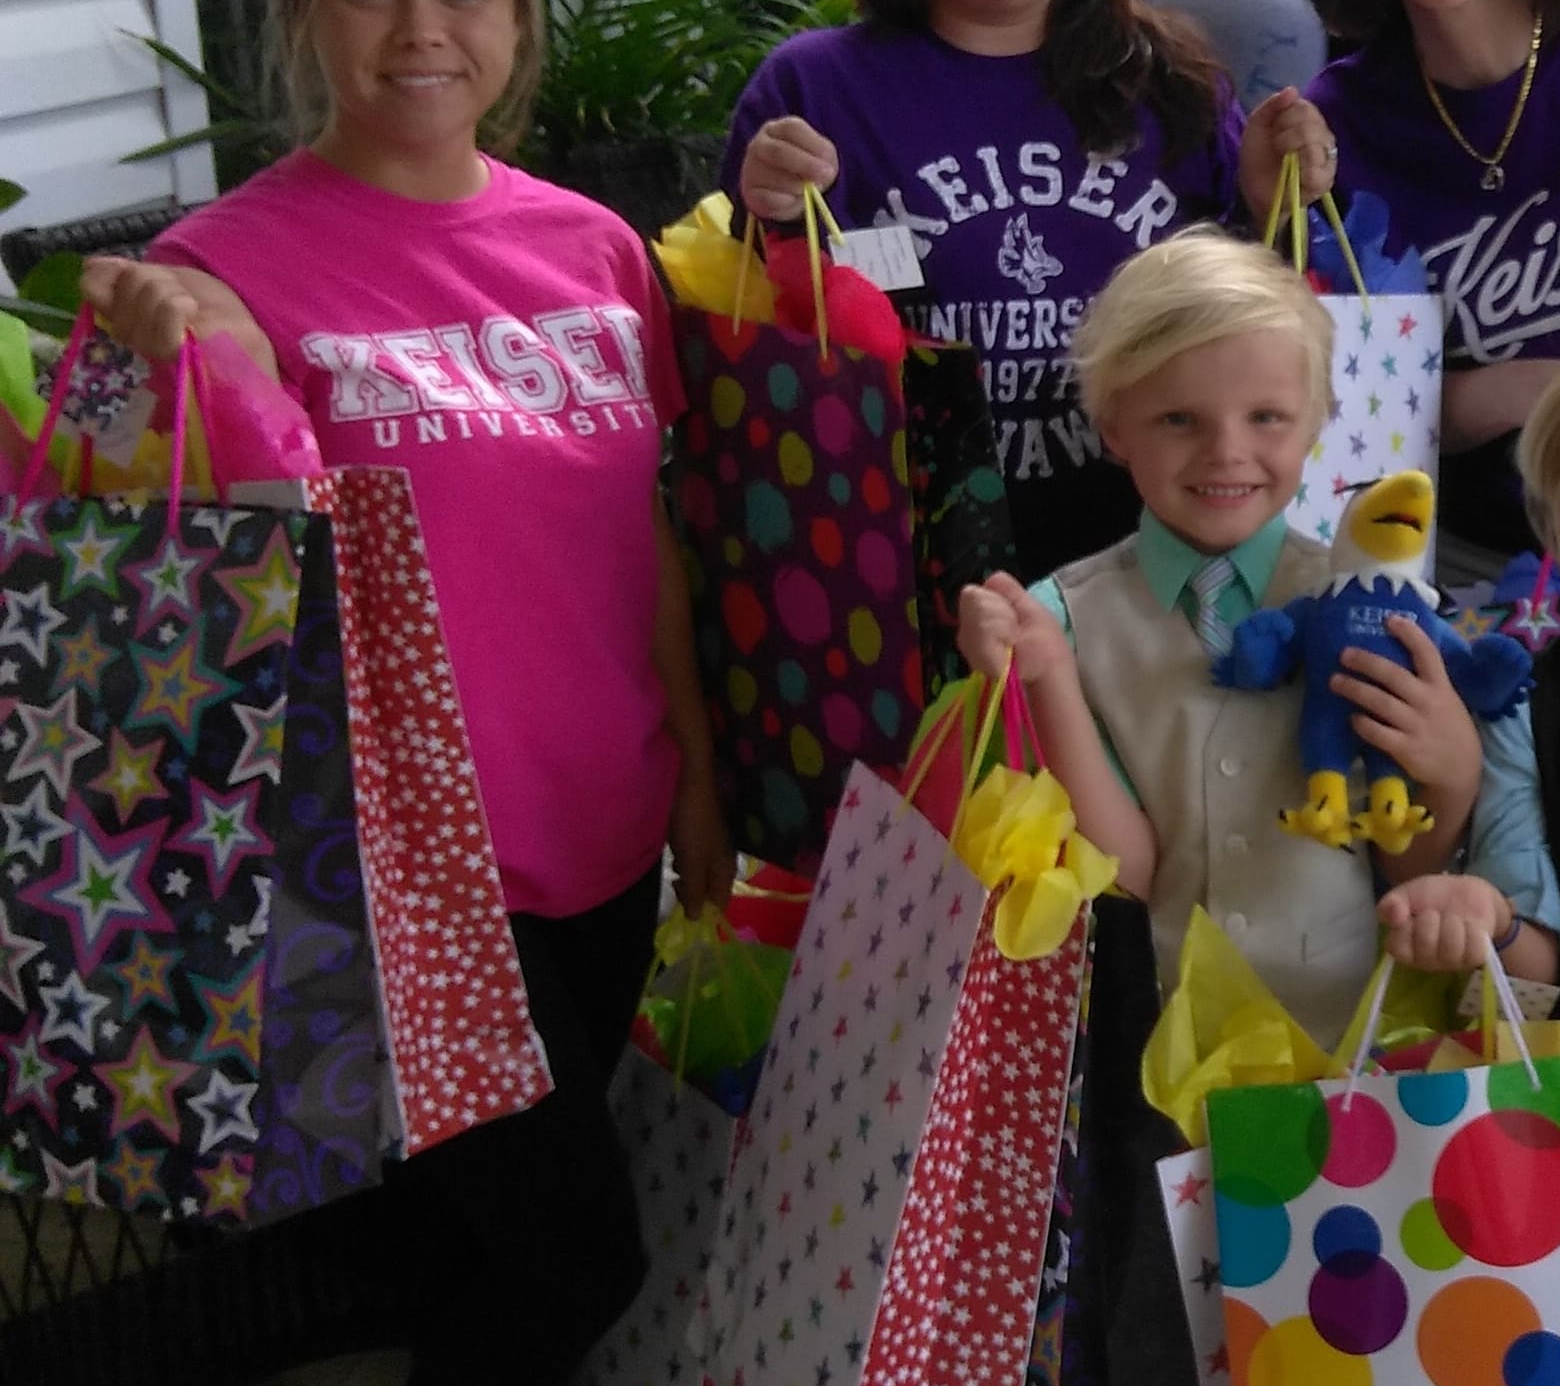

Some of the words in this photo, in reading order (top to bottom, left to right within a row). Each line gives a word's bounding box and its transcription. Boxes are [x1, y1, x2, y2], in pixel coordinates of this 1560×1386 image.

[873, 141, 1179, 261] KEISER
[904, 296, 1096, 351] UNIVERS
[982, 358, 1080, 404] 1977
